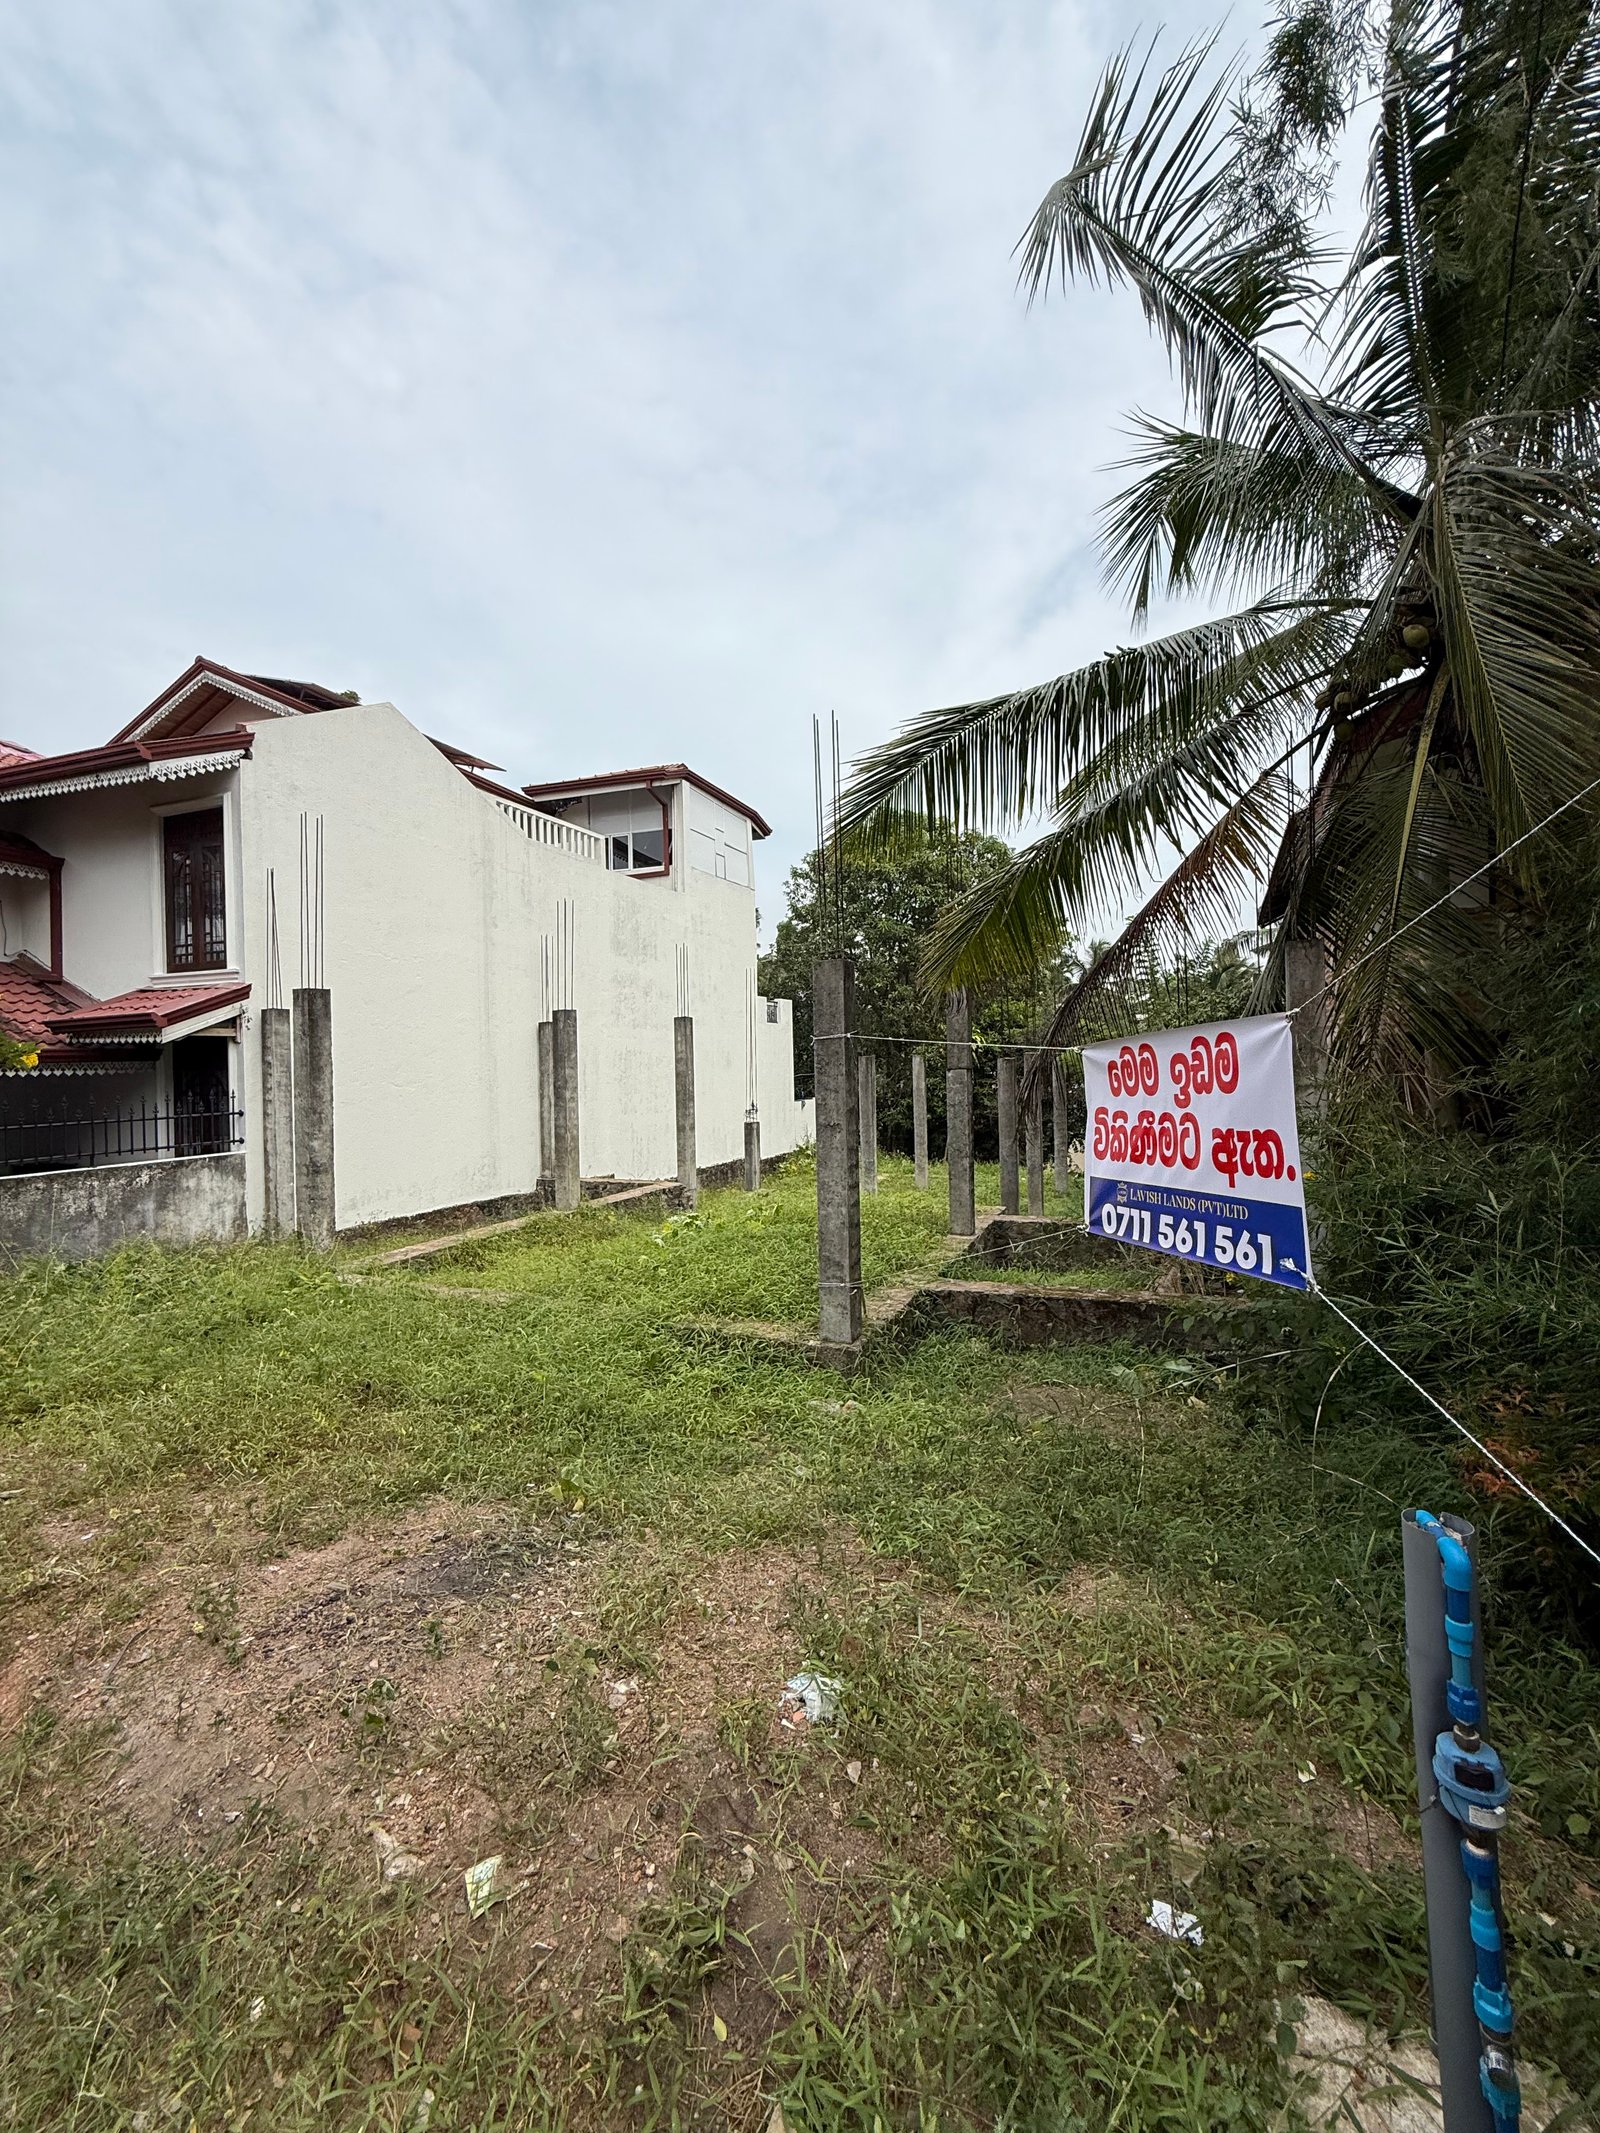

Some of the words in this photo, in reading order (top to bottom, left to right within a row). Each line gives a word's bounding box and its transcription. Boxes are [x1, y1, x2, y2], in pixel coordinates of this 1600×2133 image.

[1107, 1043, 1160, 1097] මෙම
[1170, 1031, 1240, 1108] ඉඩම
[1093, 1106, 1201, 1170] විකිණීමට
[1129, 1188, 1162, 1204] LAVISH
[1163, 1195, 1196, 1211] LANDS
[1101, 1203, 1151, 1244] 0711
[1158, 1214, 1206, 1258] 561
[1214, 1225, 1273, 1275] 561
